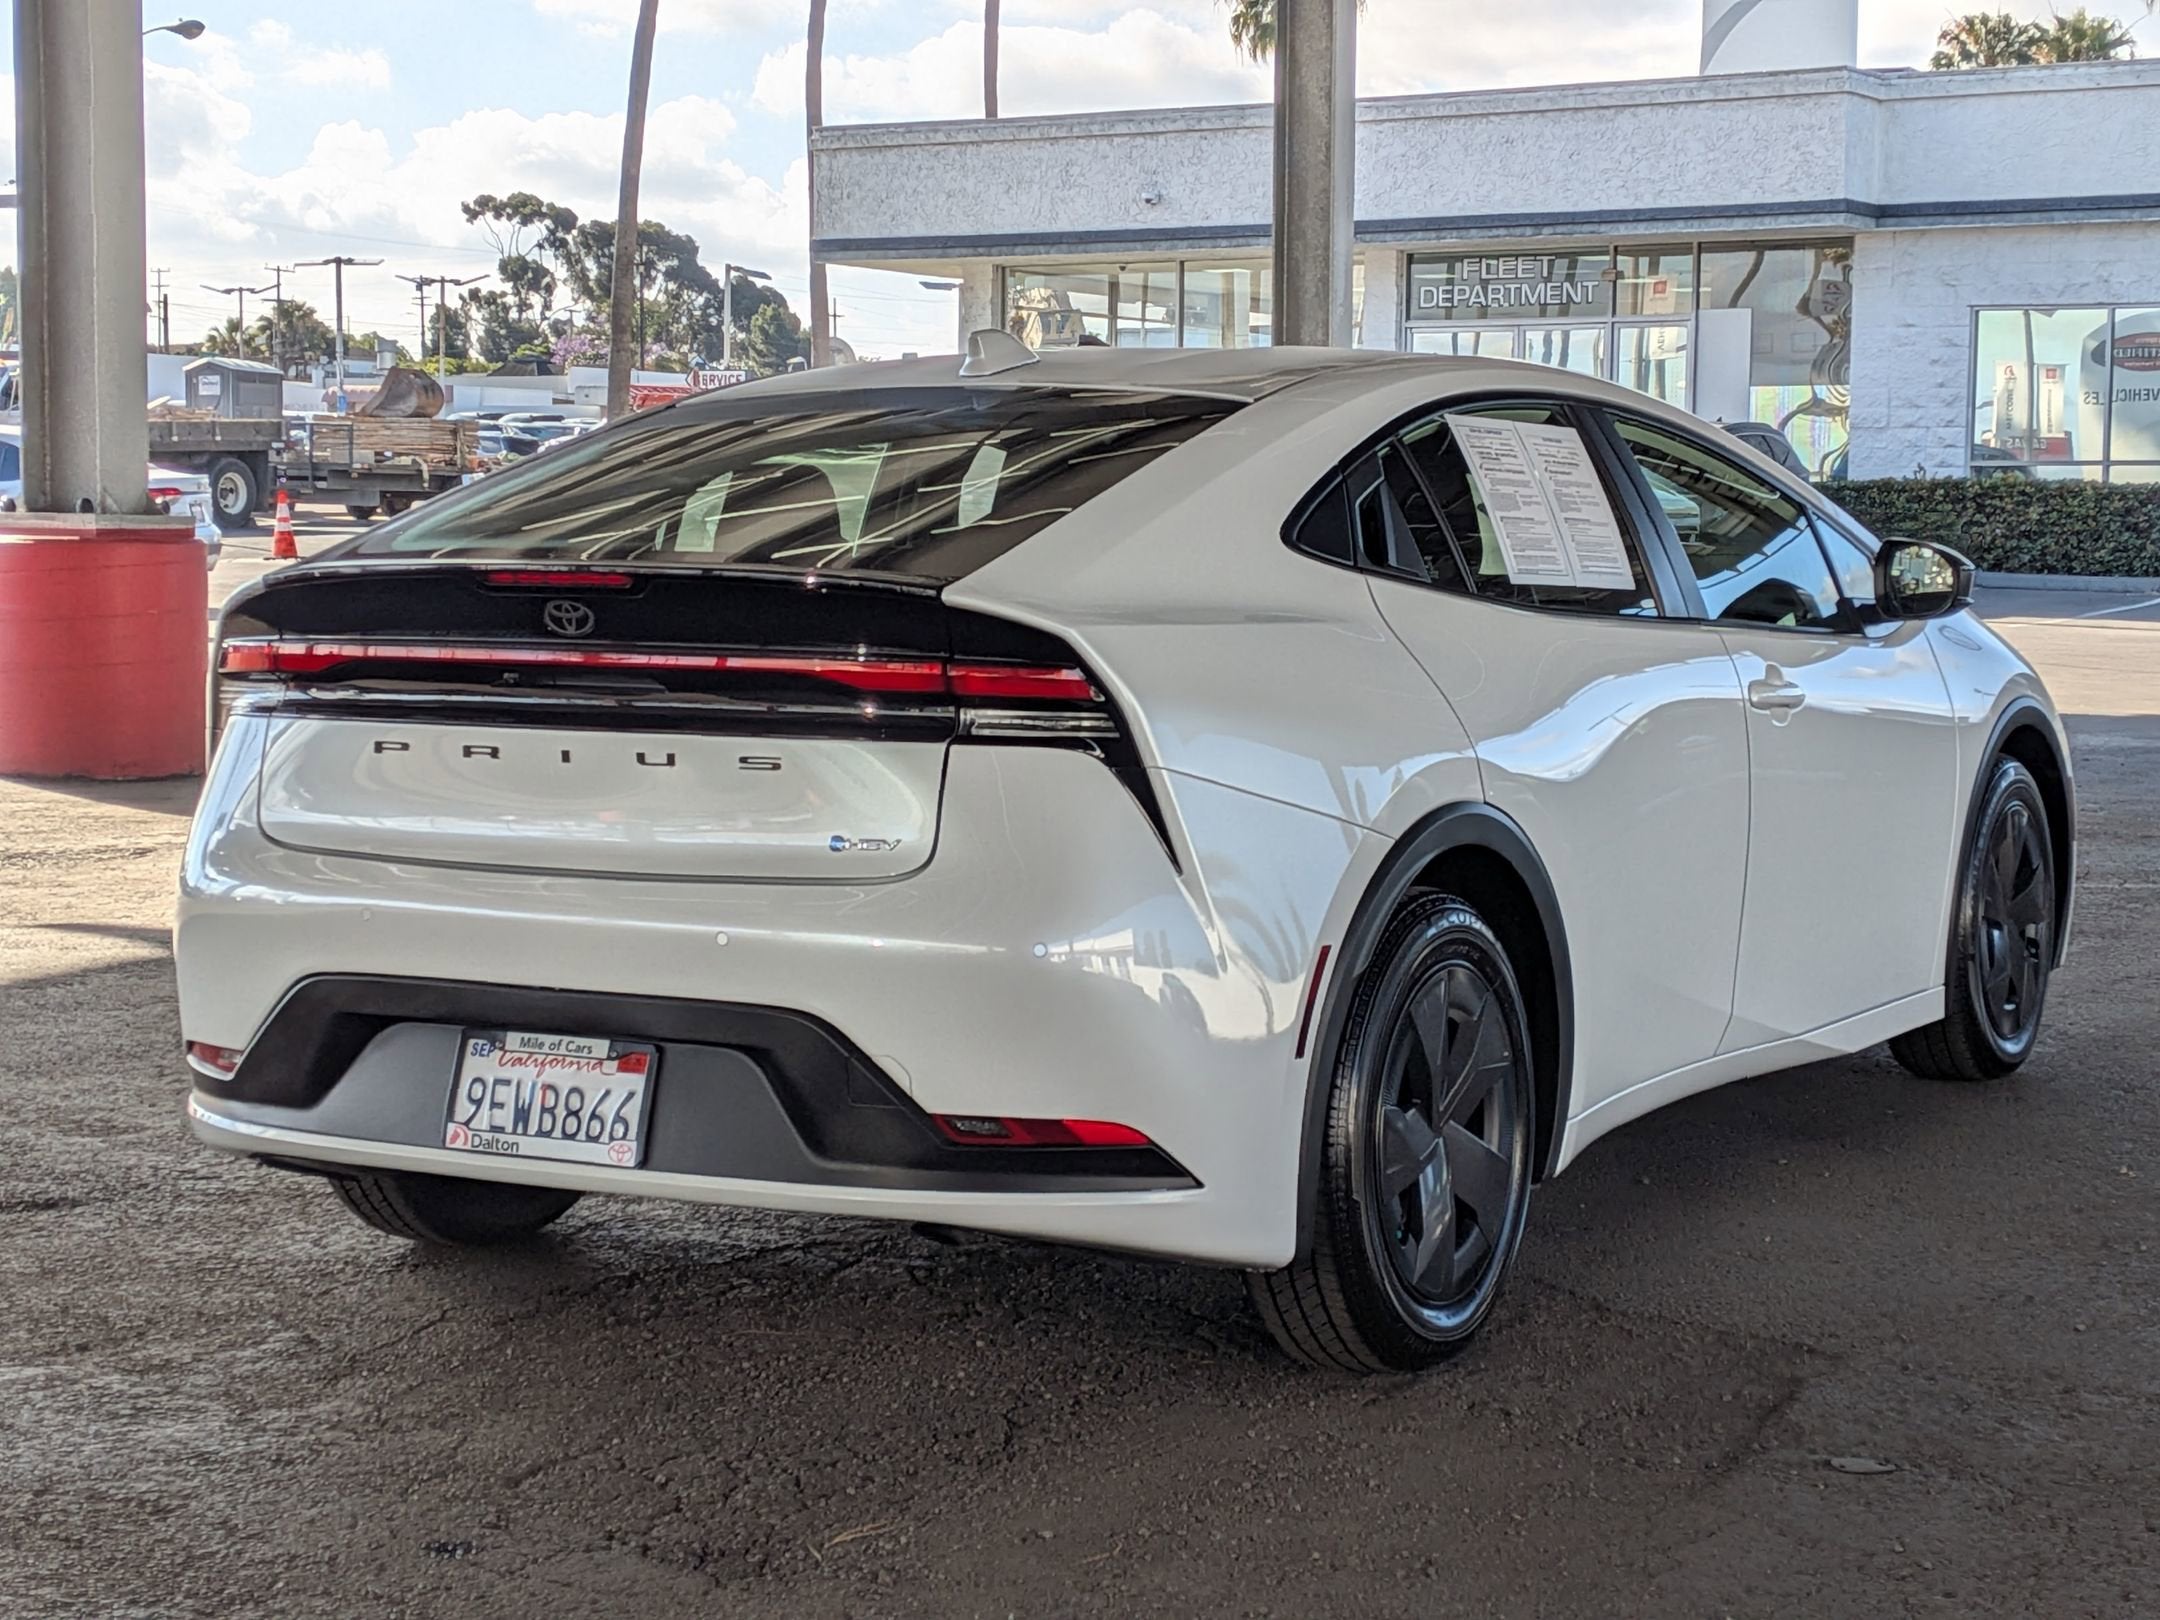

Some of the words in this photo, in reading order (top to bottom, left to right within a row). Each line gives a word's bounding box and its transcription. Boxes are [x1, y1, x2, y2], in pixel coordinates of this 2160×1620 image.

[1462, 256, 1556, 280] FLEET
[1419, 281, 1600, 309] DEPARTMENT
[373, 740, 783, 771] PRIUS
[519, 1036, 545, 1051] Mile
[549, 1039, 564, 1052] of
[565, 1040, 593, 1055] Cars
[498, 1051, 617, 1078] California
[464, 1077, 637, 1144] 9EWB866
[471, 1133, 519, 1153] Dalton
